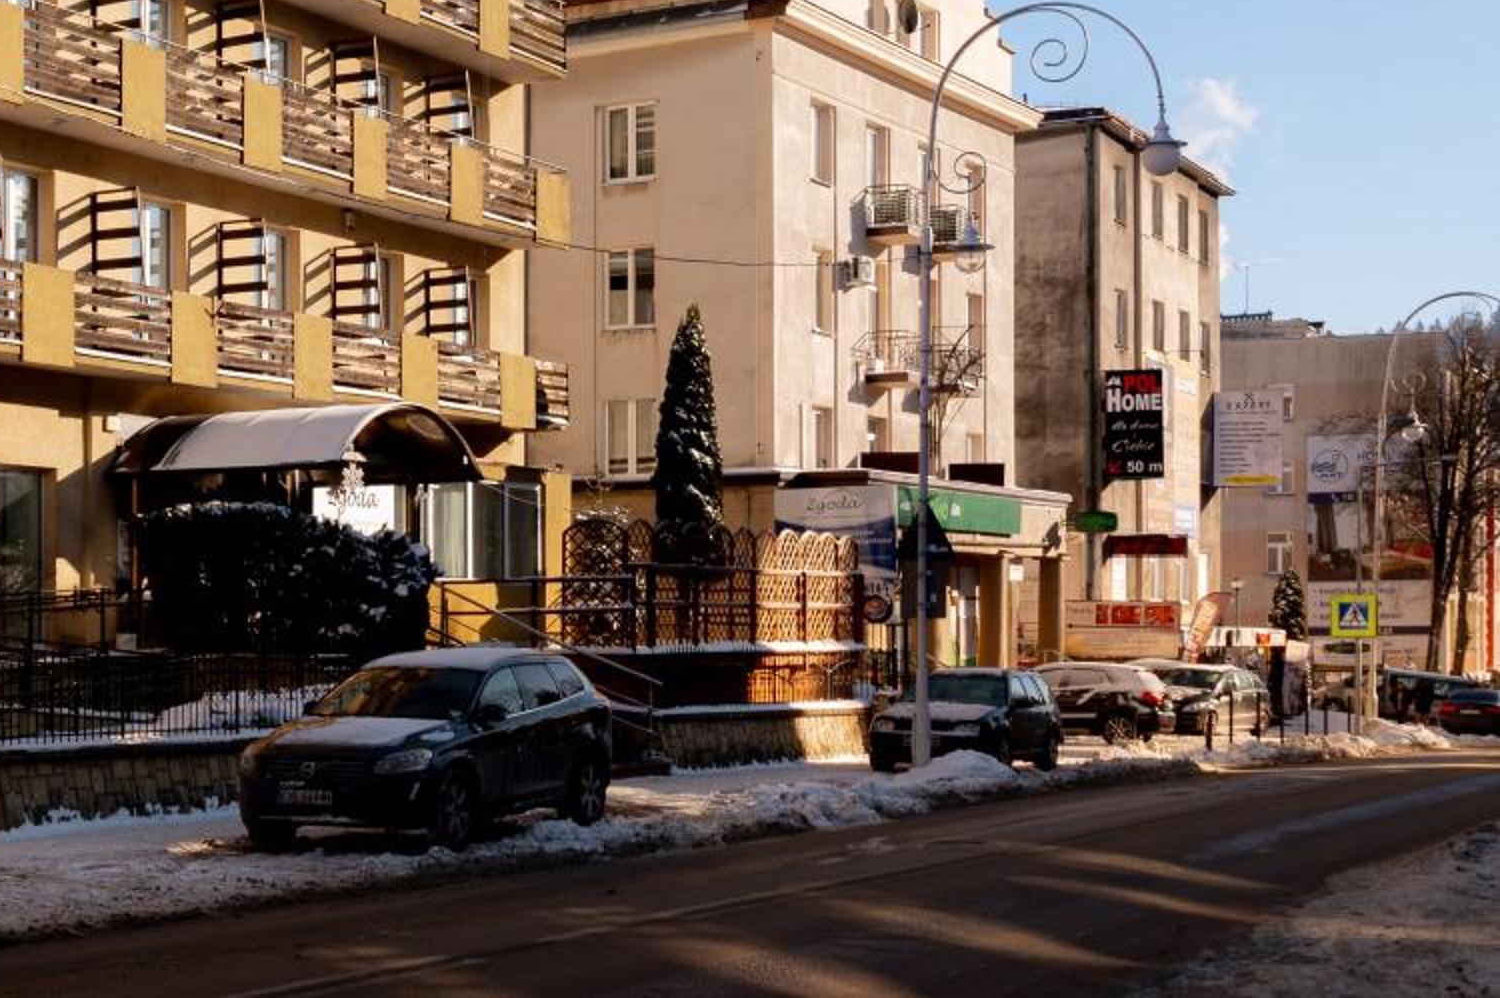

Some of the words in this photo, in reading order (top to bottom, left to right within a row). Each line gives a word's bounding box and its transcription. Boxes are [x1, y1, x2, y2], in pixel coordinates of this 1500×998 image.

[1123, 374, 1159, 393] POL
[1127, 459, 1145, 473] 50
[1148, 462, 1163, 473] m
